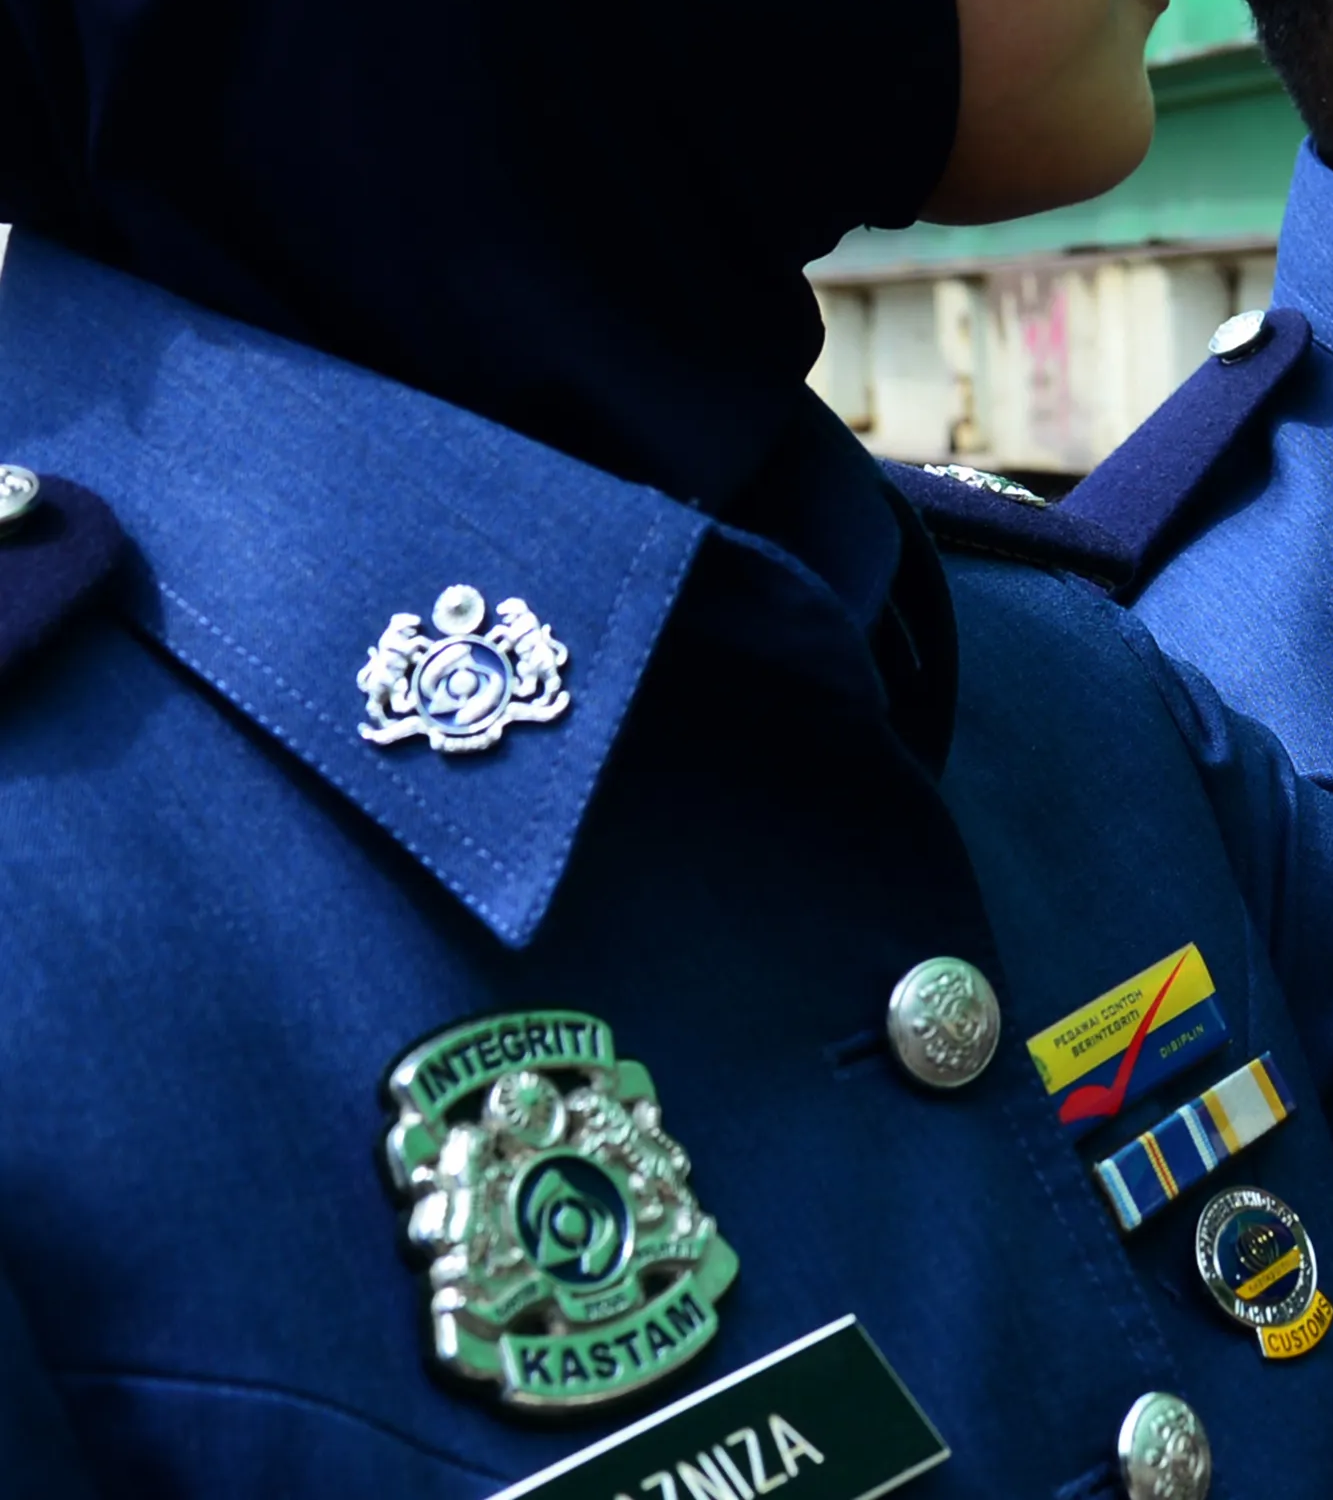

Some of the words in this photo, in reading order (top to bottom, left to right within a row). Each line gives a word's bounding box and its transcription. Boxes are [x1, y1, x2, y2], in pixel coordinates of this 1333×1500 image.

[1053, 1015, 1099, 1049] PEGAWAI
[1101, 989, 1143, 1020] CONTOH
[1071, 1008, 1141, 1059] BERINTEGRITI
[417, 1020, 599, 1102] INTEGRITI
[519, 1291, 708, 1387] KASTAM
[1267, 1296, 1332, 1352] CUSTOMS
[614, 1413, 826, 1500] ZNIZA
